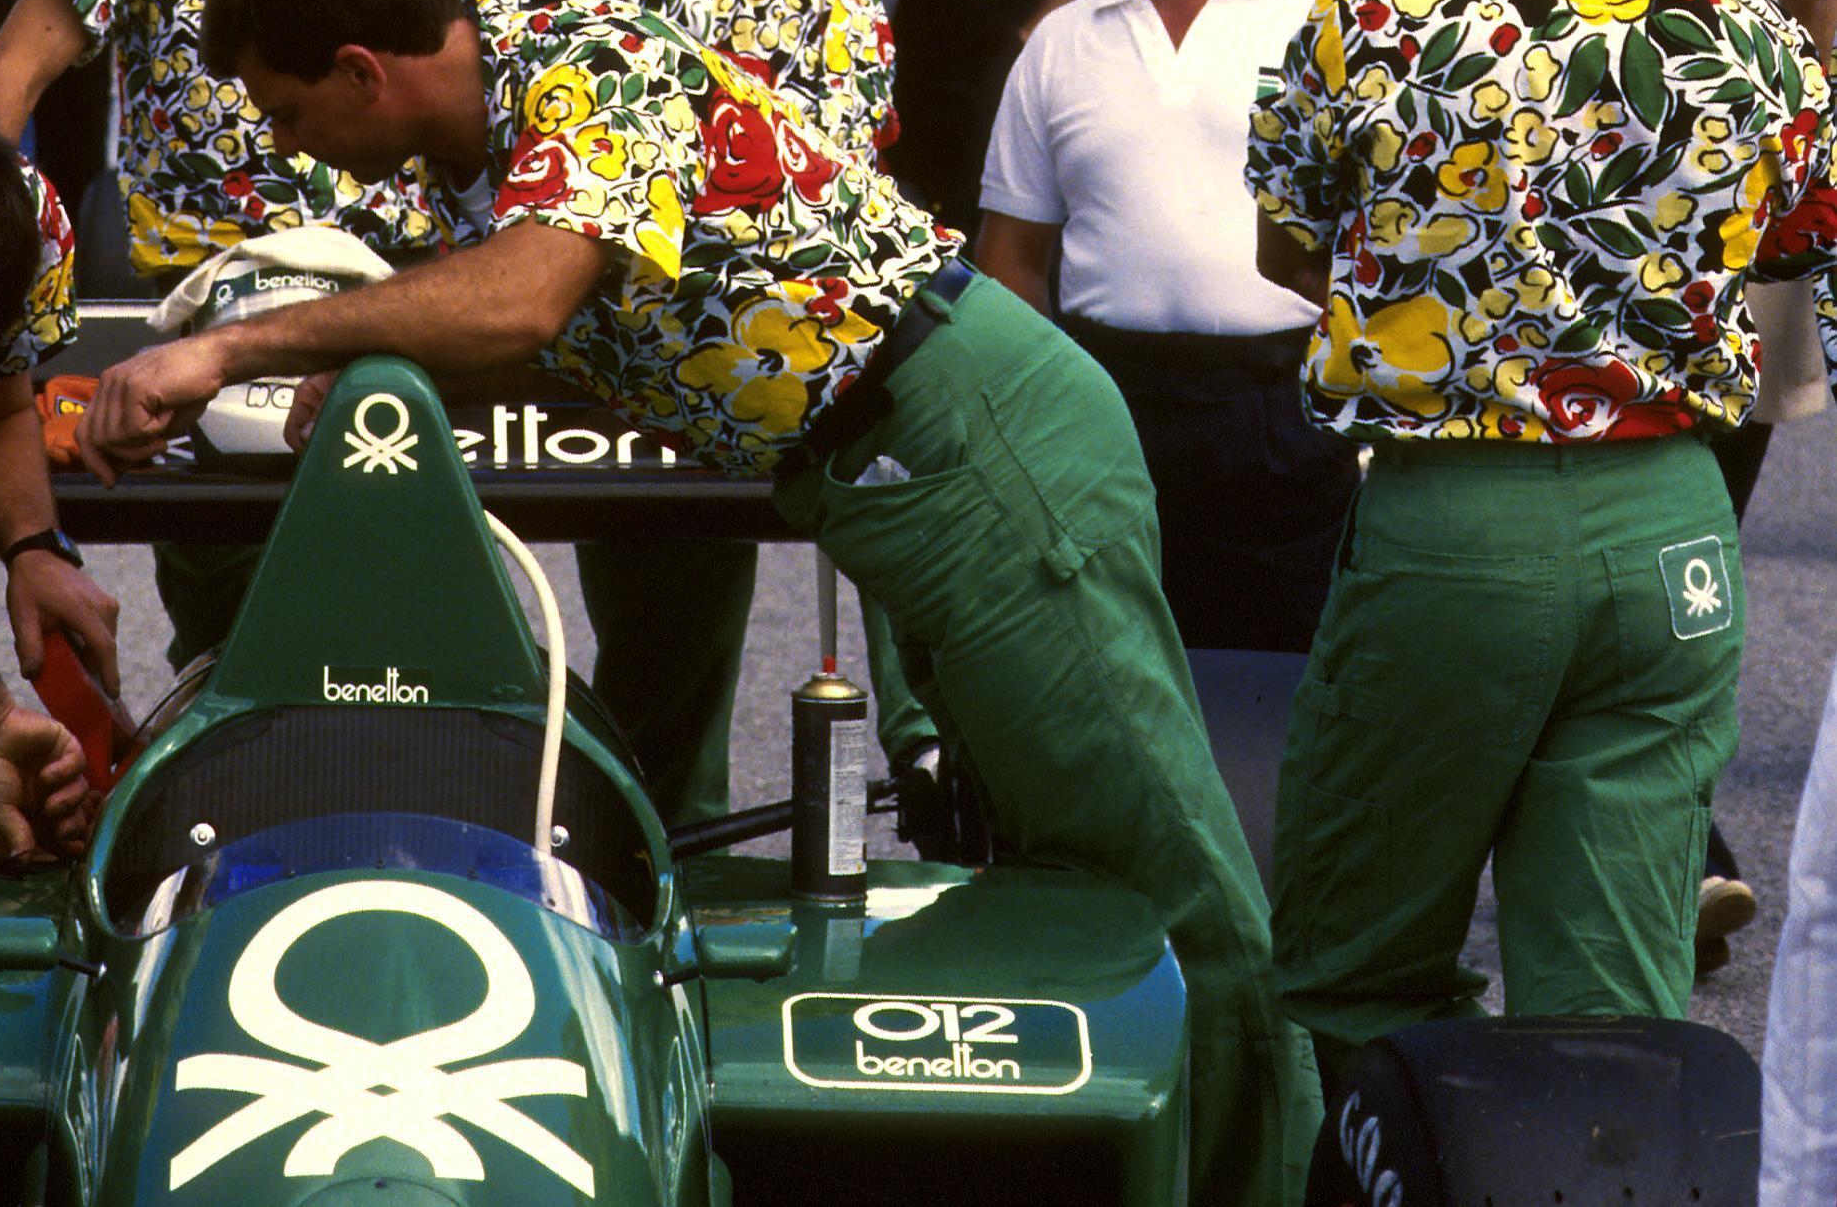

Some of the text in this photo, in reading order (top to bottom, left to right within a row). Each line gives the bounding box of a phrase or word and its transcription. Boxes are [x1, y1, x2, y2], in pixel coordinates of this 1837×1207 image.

[452, 405, 677, 464] etton
[323, 665, 429, 705] benetton
[855, 1041, 1021, 1081] benetton
